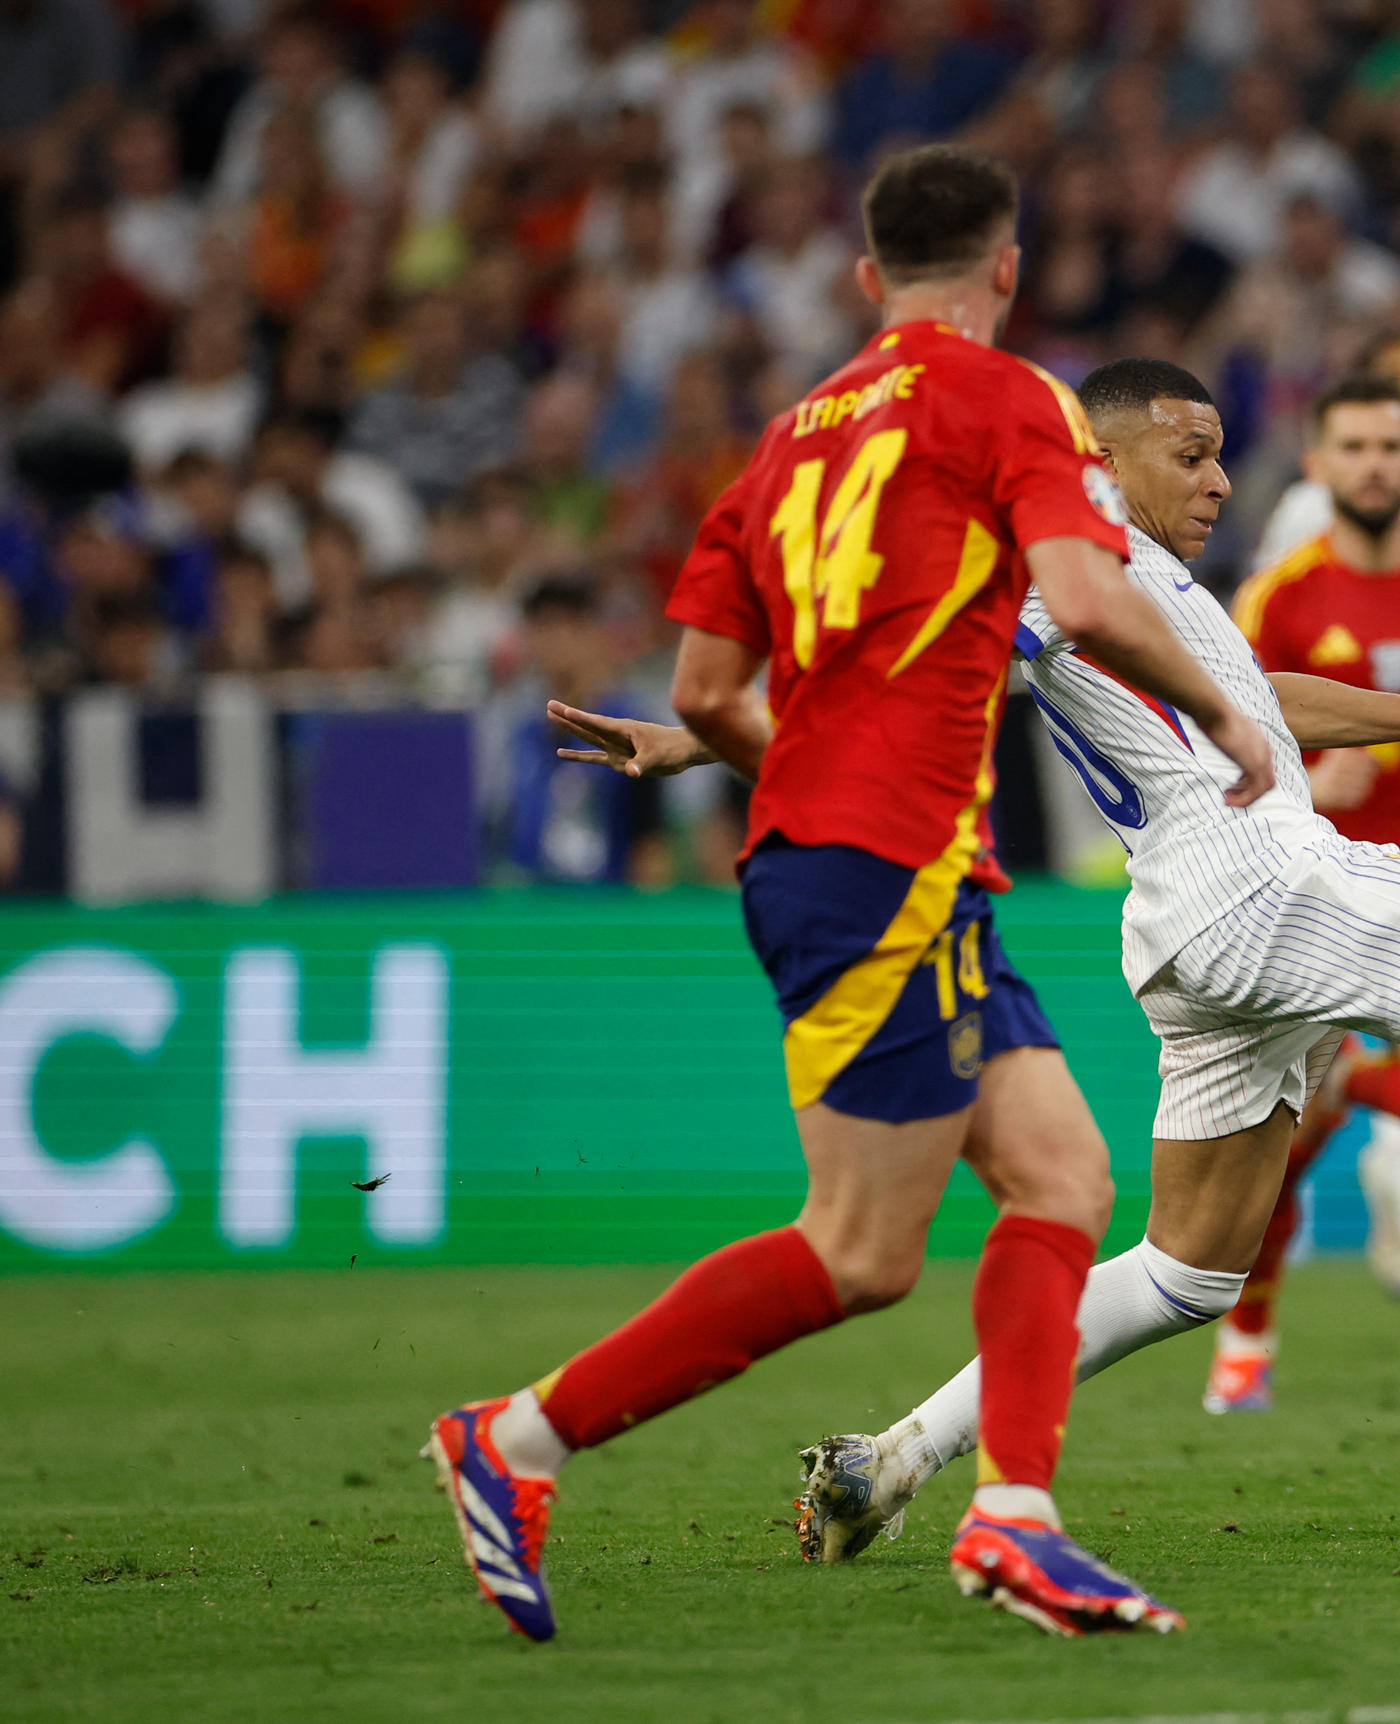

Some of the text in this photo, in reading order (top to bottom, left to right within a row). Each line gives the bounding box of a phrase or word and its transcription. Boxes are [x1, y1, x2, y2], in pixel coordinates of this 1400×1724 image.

[769, 428, 907, 670] 14
[922, 920, 990, 1020] 14
[0, 944, 450, 1252] CH
